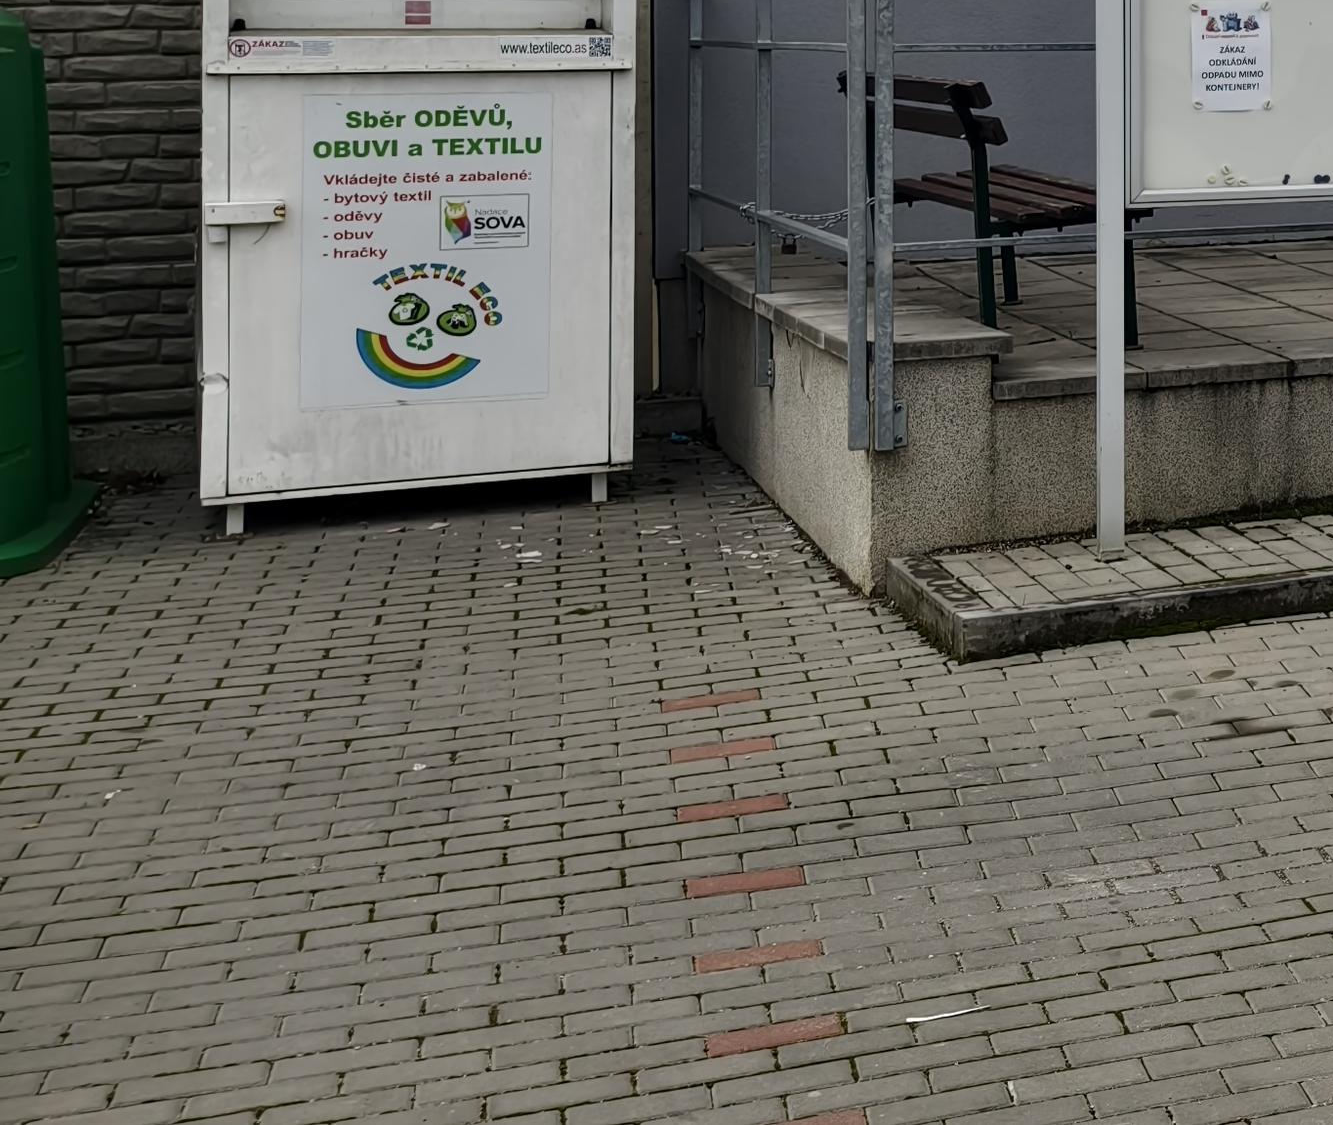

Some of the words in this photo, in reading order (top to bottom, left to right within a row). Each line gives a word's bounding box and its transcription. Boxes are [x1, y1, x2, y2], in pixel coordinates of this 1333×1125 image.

[500, 42, 587, 55] www.textileco.as
[1219, 44, 1246, 54] ZÁKAZ
[1208, 56, 1257, 66] ODKLÁDÁNÍ
[1201, 71, 1237, 79] ODPADU
[1238, 70, 1264, 78] MIMO
[1205, 82, 1260, 92] KONTEJNERY!
[346, 110, 406, 129] Sběr
[414, 103, 513, 130] ODĚVŮ,
[313, 139, 398, 159] OBUVI
[408, 142, 423, 156] a
[432, 137, 542, 156] TEXTILU
[323, 173, 397, 187] Vkládejte
[403, 171, 440, 184] čisté
[445, 174, 454, 182] a
[459, 170, 532, 182] zabalené:
[334, 190, 388, 206] bytový
[393, 190, 432, 202] textil
[333, 210, 383, 224] oděvy
[474, 216, 526, 230] SOVA
[333, 229, 374, 240] obuv
[333, 247, 388, 260] hračky
[372, 263, 467, 291] TEXTIL
[469, 281, 503, 326] ECO
